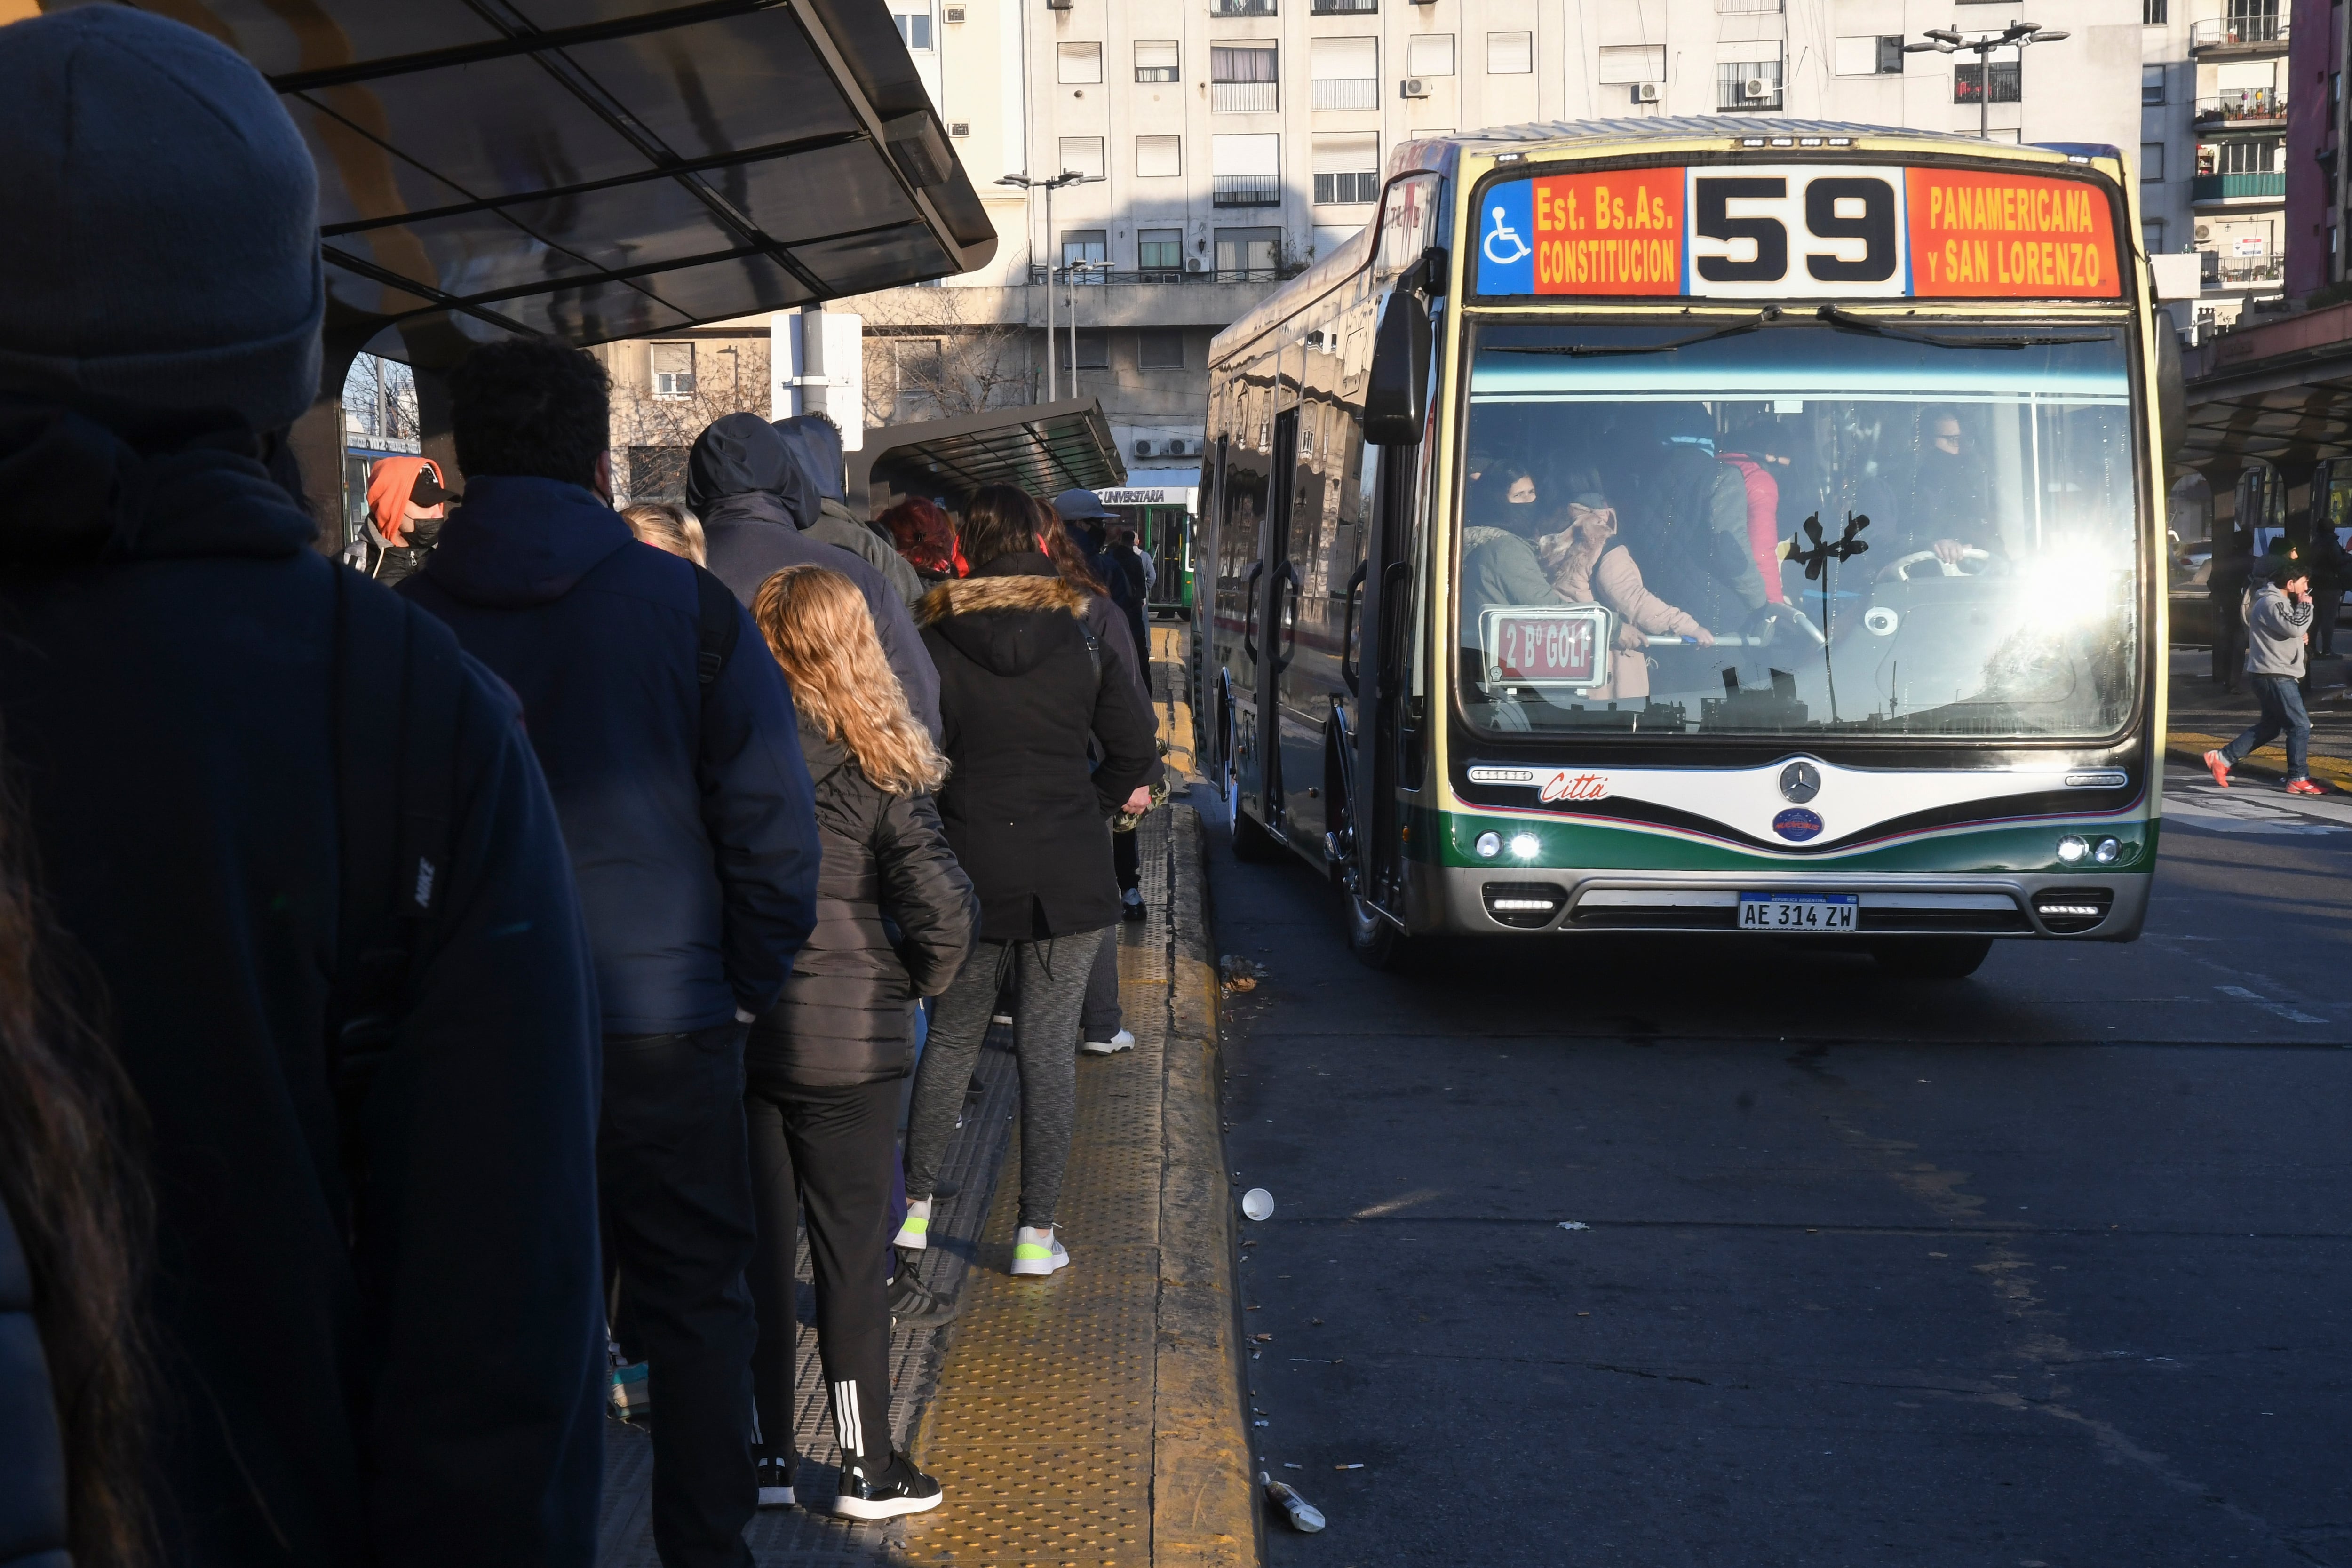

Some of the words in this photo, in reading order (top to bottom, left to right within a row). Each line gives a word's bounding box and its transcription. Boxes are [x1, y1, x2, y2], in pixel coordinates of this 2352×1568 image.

[1537, 187, 1585, 231] Est.
[1595, 185, 1673, 230] Bs.As.
[1695, 176, 1897, 283] 59
[1930, 186, 2093, 233] PANAMERICANA
[1539, 239, 1675, 284] CONSTITUCION
[1945, 239, 1989, 283] SAN
[1997, 240, 2100, 287] LORENZO
[368, 437, 386, 451] 102
[1104, 490, 1164, 503] UNIVERSITARIA
[1506, 624, 1517, 668] 2
[1546, 624, 1589, 668] GOLF
[414, 856, 436, 909] NIKE
[1744, 904, 1770, 925] AE
[1778, 905, 1817, 926] 314
[1825, 906, 1852, 927] ZW
